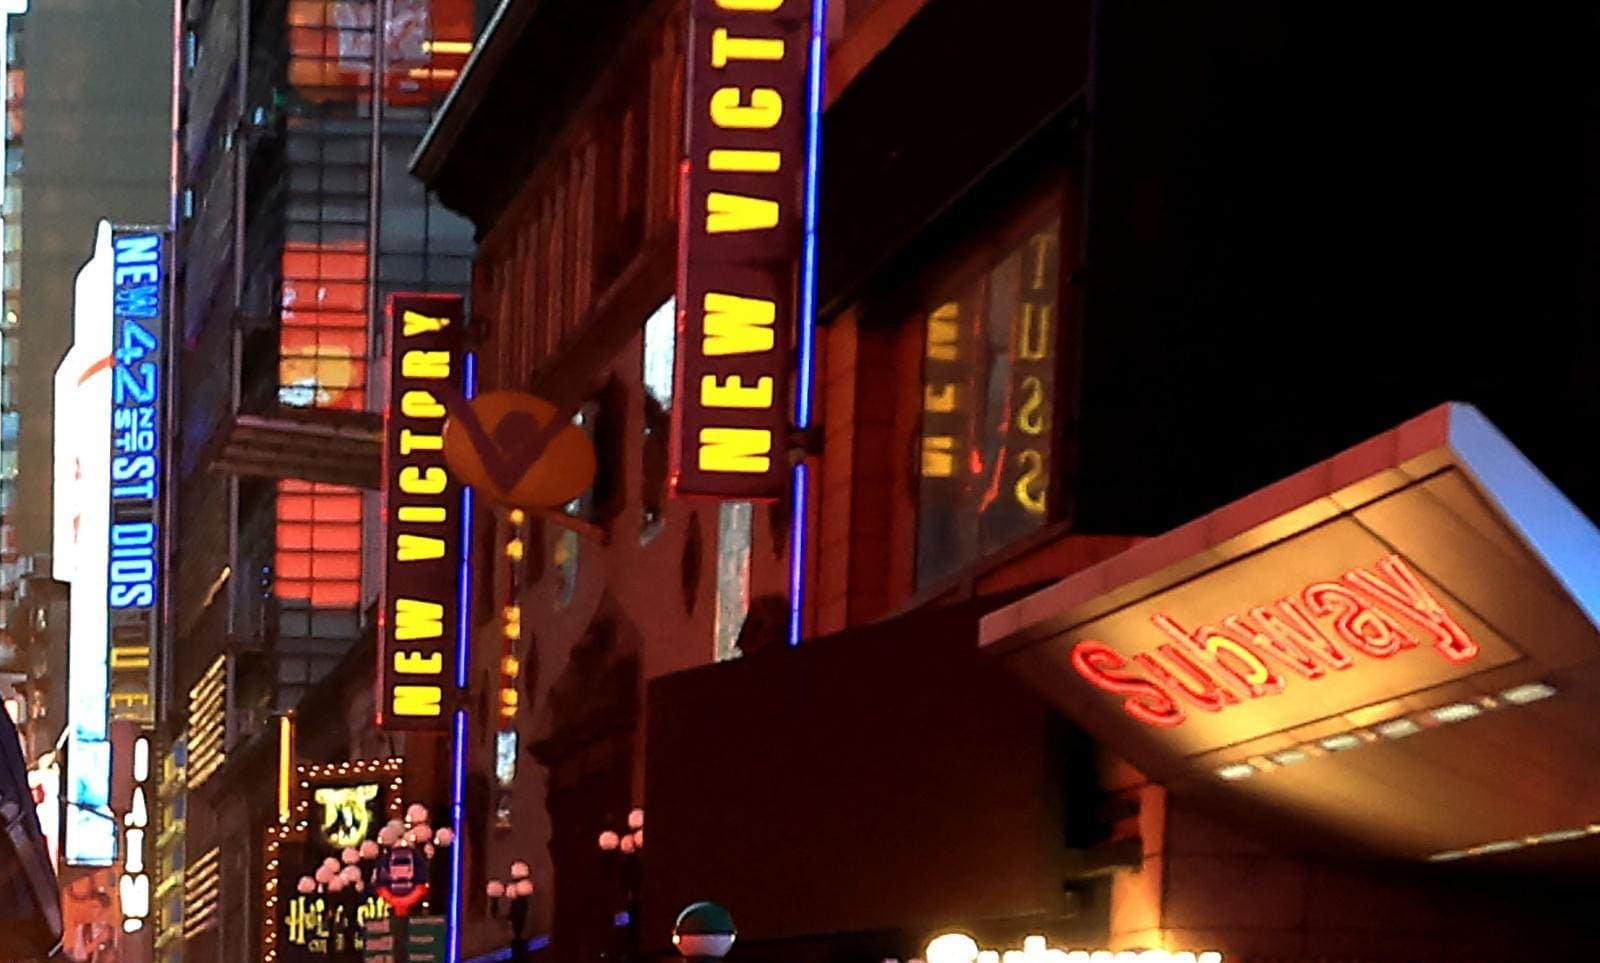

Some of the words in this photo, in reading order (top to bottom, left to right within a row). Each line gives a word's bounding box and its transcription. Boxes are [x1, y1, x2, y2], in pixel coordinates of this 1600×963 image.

[706, 0, 786, 234] VICT
[115, 235, 159, 318] NEW
[398, 310, 451, 561] VICTORY
[699, 292, 776, 473] NEW
[393, 598, 444, 716] NEW
[1071, 554, 1479, 728] Subway
